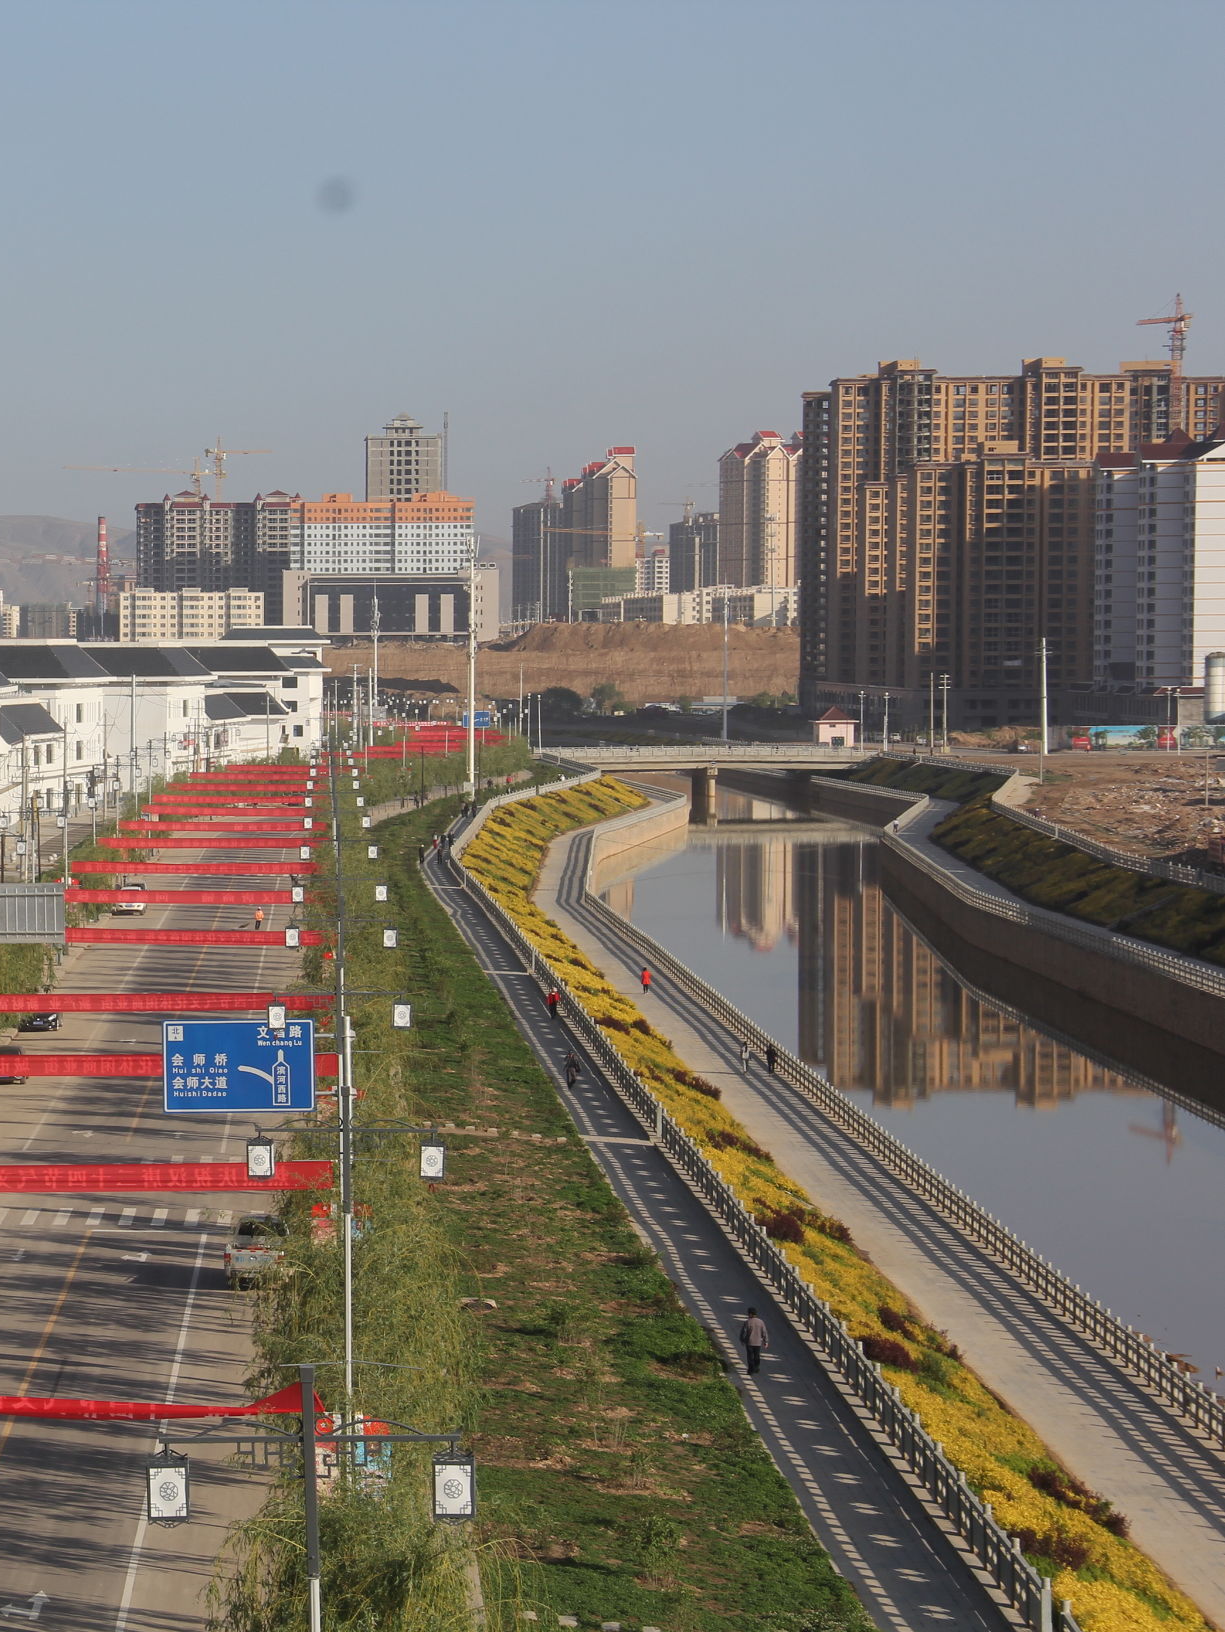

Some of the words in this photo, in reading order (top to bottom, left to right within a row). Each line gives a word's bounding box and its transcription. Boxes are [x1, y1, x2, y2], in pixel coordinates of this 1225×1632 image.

[171, 1026, 180, 1035] 北
[271, 1040, 293, 1048] chang
[171, 1053, 228, 1067] 会师桥
[172, 1076, 228, 1090] 会师大道
[276, 1066, 287, 1104] 滨河西路
